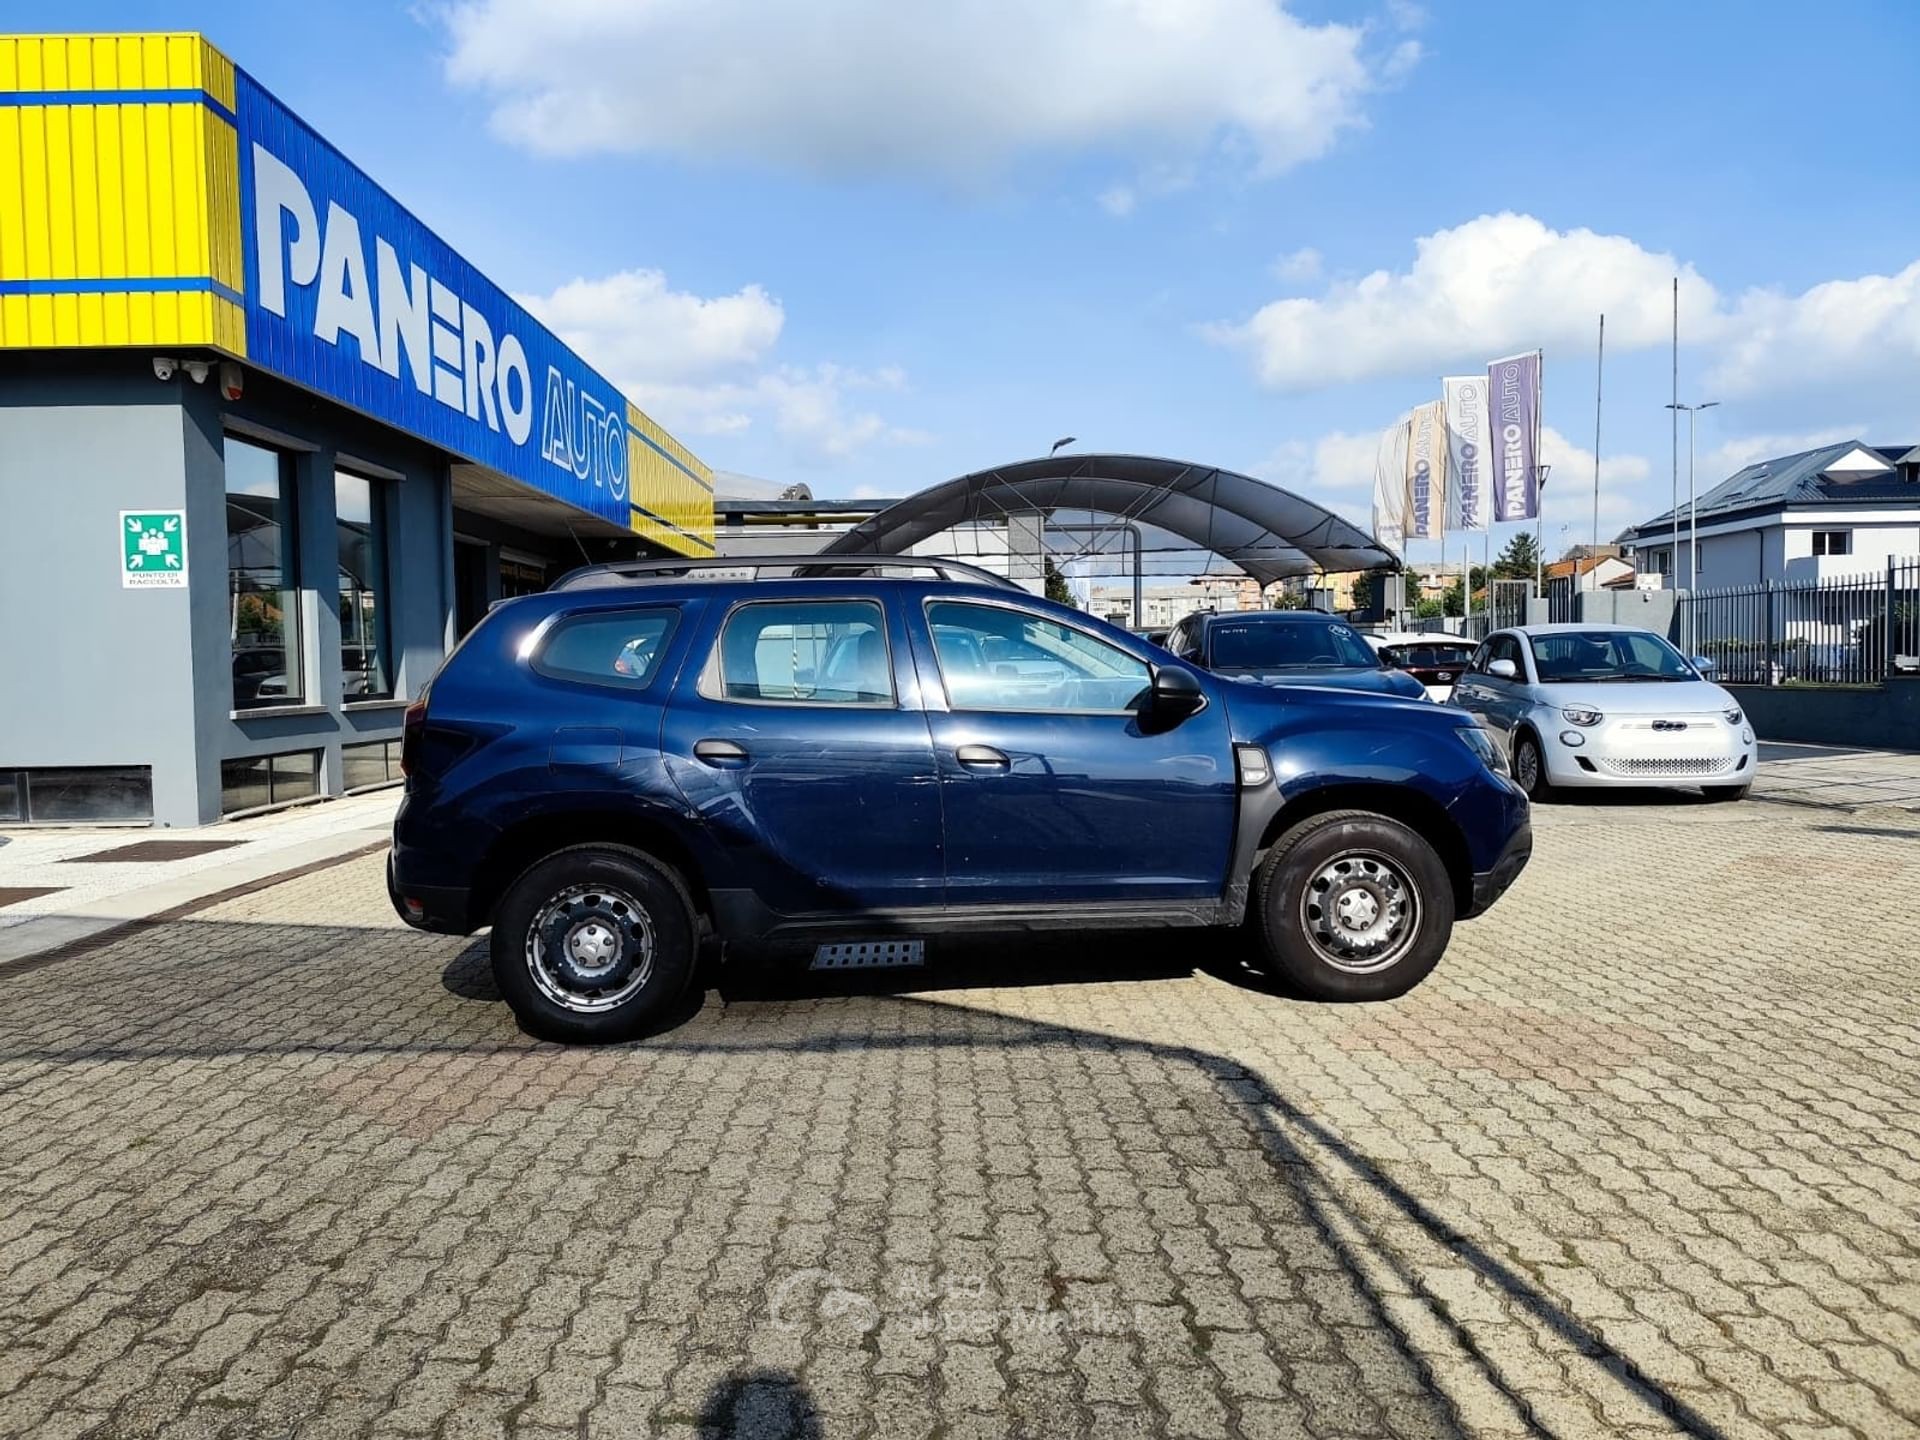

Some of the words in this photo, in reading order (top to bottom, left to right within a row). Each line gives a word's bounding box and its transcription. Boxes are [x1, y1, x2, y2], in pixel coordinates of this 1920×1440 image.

[253, 142, 532, 446] PANERO
[541, 365, 628, 502] AUTO
[1459, 385, 1478, 441] AUTO
[1502, 363, 1521, 423] AUTO
[1414, 460, 1430, 536] PANERO
[1504, 424, 1527, 518] PANERO
